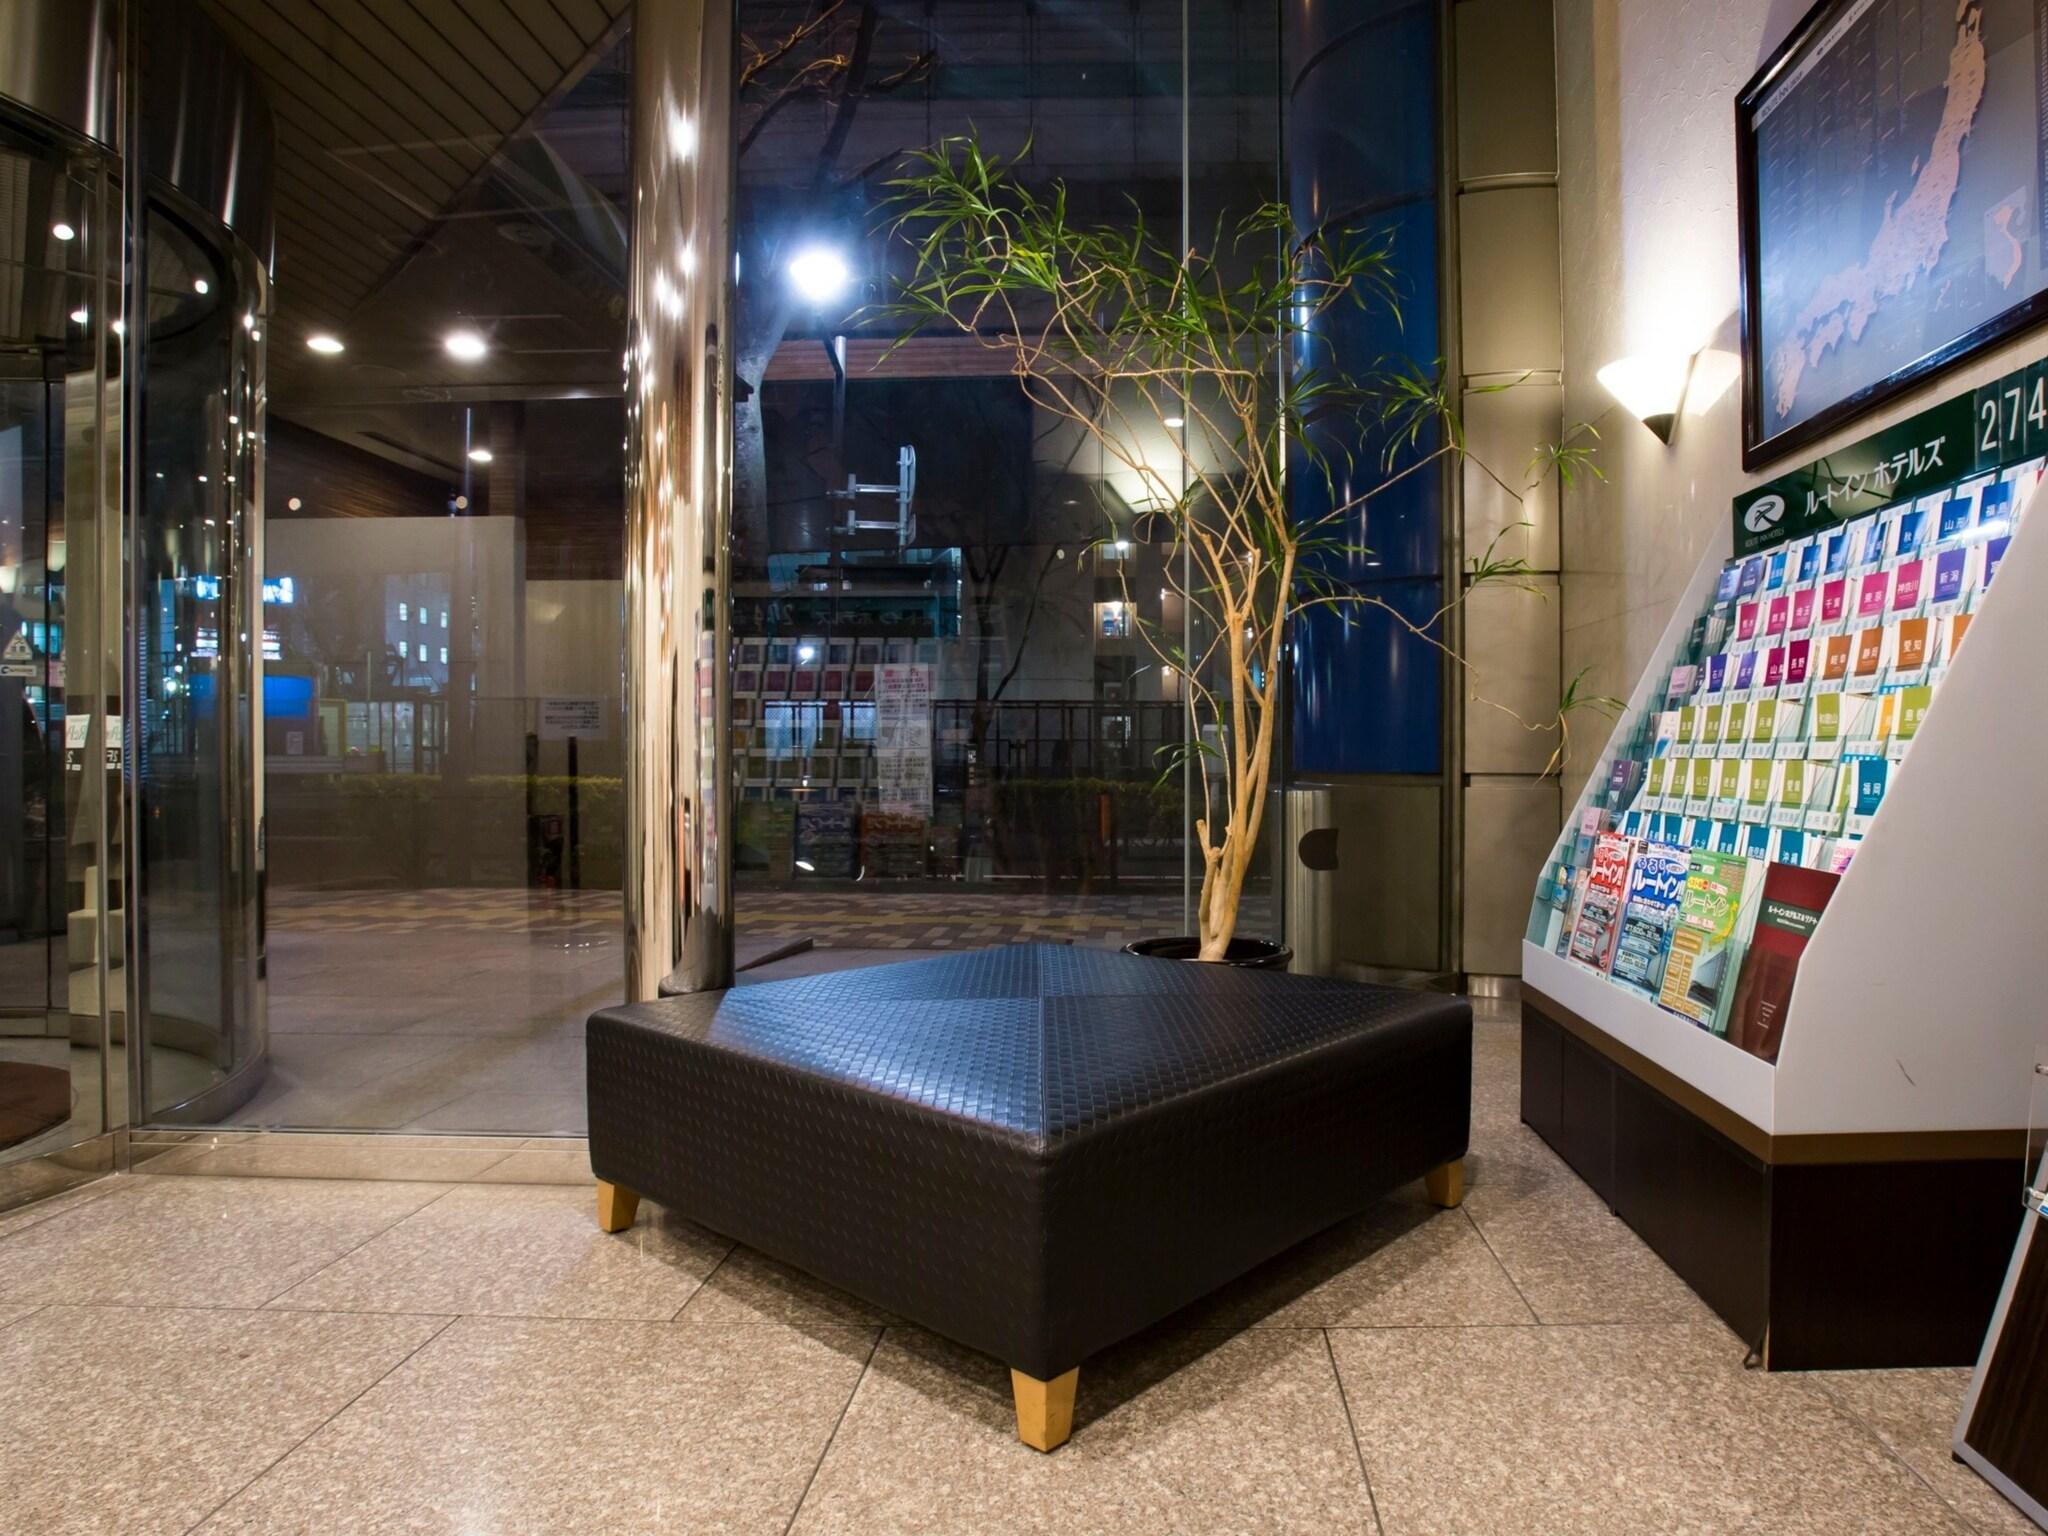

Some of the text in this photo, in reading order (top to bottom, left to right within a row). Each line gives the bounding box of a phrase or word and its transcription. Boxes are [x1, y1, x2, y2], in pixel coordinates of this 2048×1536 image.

[1804, 435, 1946, 517] ルートイン ホテルズ
[1903, 639, 1922, 652] 愛知
[1685, 889, 1729, 917] ルートイン
